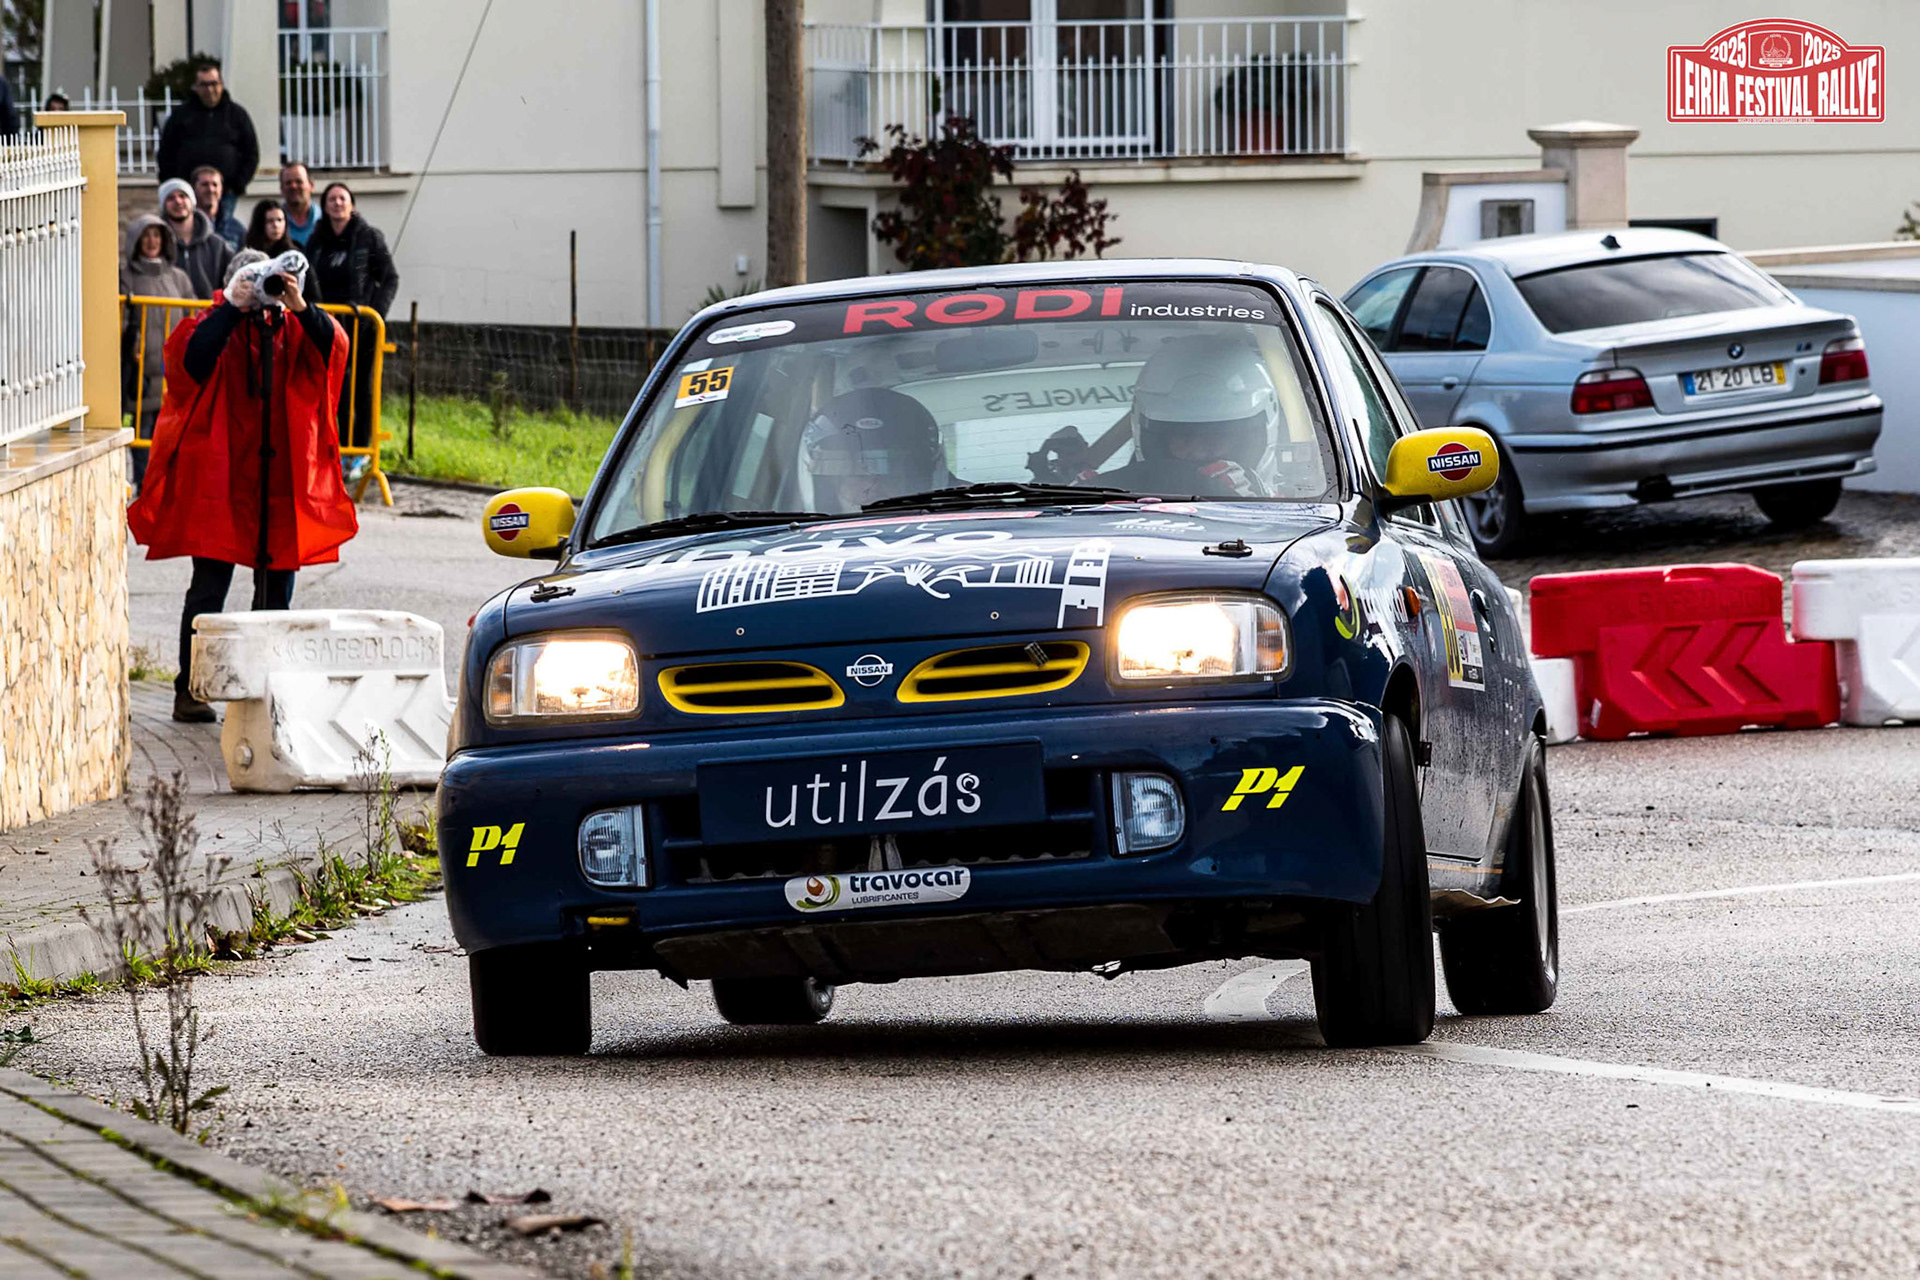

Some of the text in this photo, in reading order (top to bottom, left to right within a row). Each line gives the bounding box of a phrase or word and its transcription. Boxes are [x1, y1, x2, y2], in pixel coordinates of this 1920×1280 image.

[842, 287, 1266, 334] RODI industries
[688, 369, 730, 396] 55
[1430, 453, 1479, 470] NISSAN
[491, 515, 527, 528] NISSAN
[850, 665, 889, 675] NISSAN
[765, 756, 982, 828] utilzás
[1220, 765, 1306, 812] P1
[465, 822, 526, 868] P1
[849, 869, 966, 894] travocar
[851, 891, 920, 905] LUBRIFICANTES
